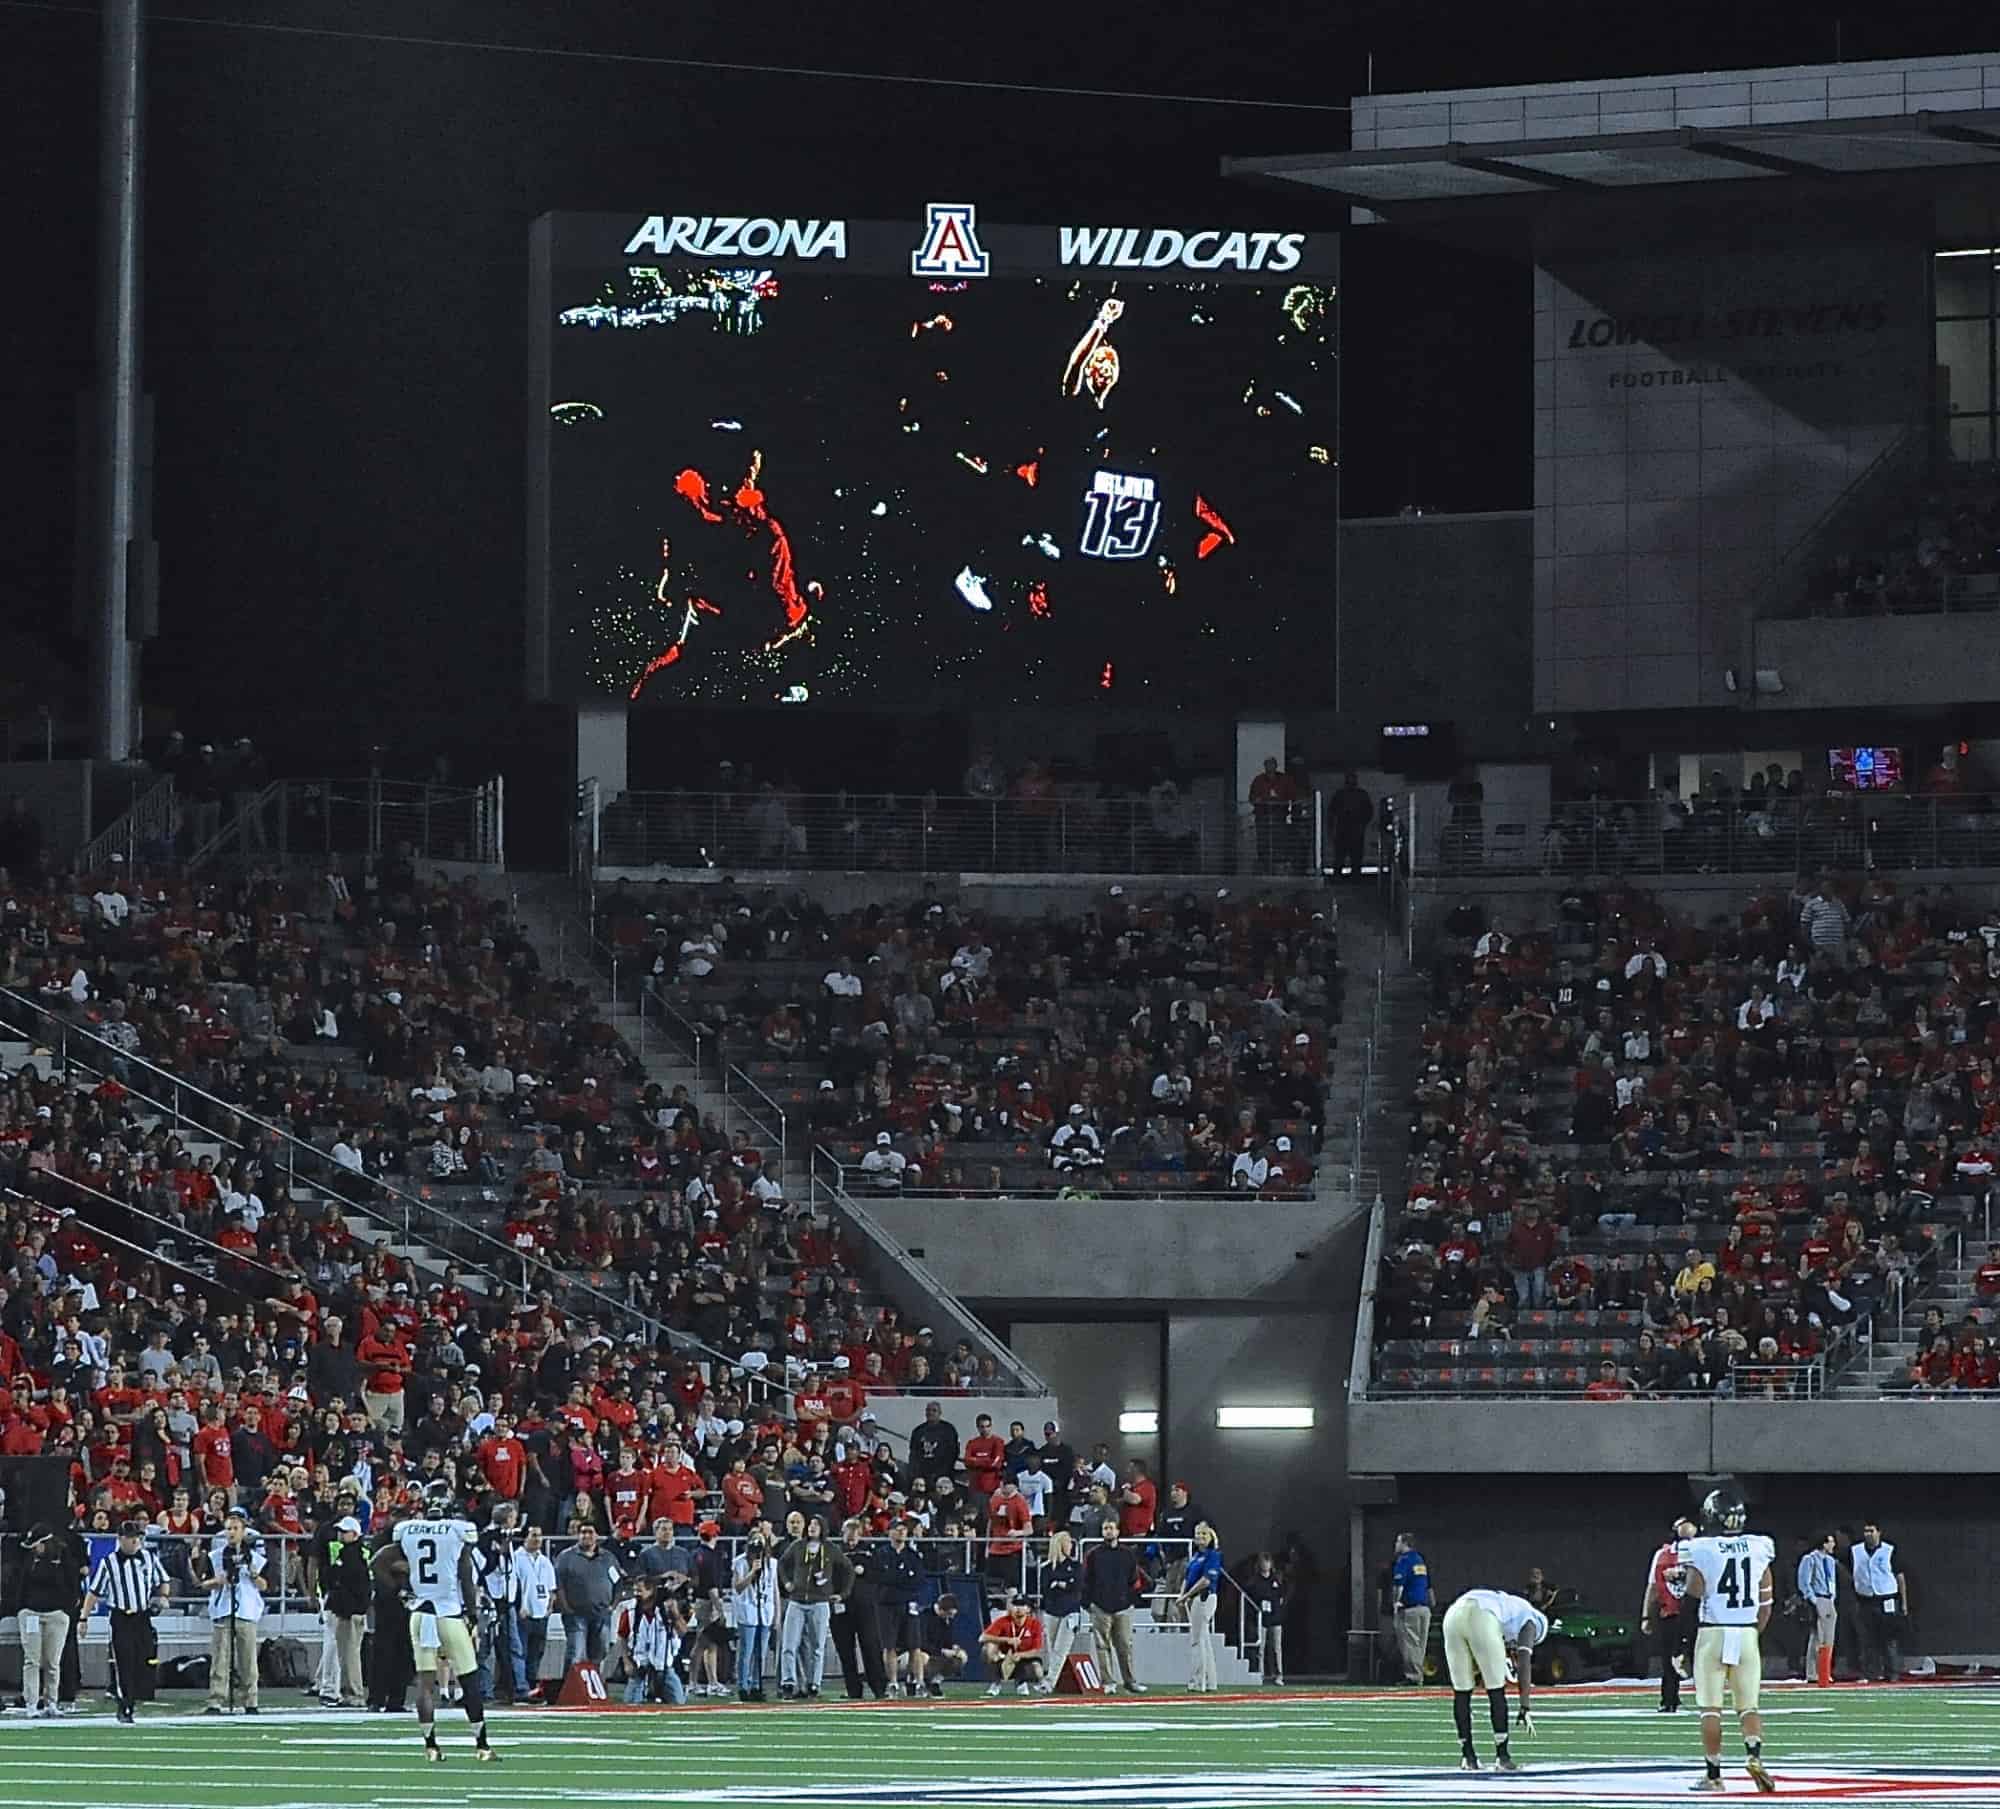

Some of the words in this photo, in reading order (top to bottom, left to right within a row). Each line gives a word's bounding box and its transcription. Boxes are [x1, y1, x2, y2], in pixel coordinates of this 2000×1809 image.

[624, 216, 846, 258] ARIZONA
[912, 203, 989, 276] A
[1060, 227, 1305, 271] WILDCATS
[1610, 369, 1727, 389] FOOTBALL
[1080, 491, 1160, 557] 13
[408, 1524, 451, 1535] CRAWLEY
[417, 1539, 438, 1585] 2
[1718, 1540, 1749, 1554] SMITH
[1717, 1557, 1754, 1609] 41
[580, 1669, 607, 1700] 20
[1076, 1661, 1100, 1689] 10
